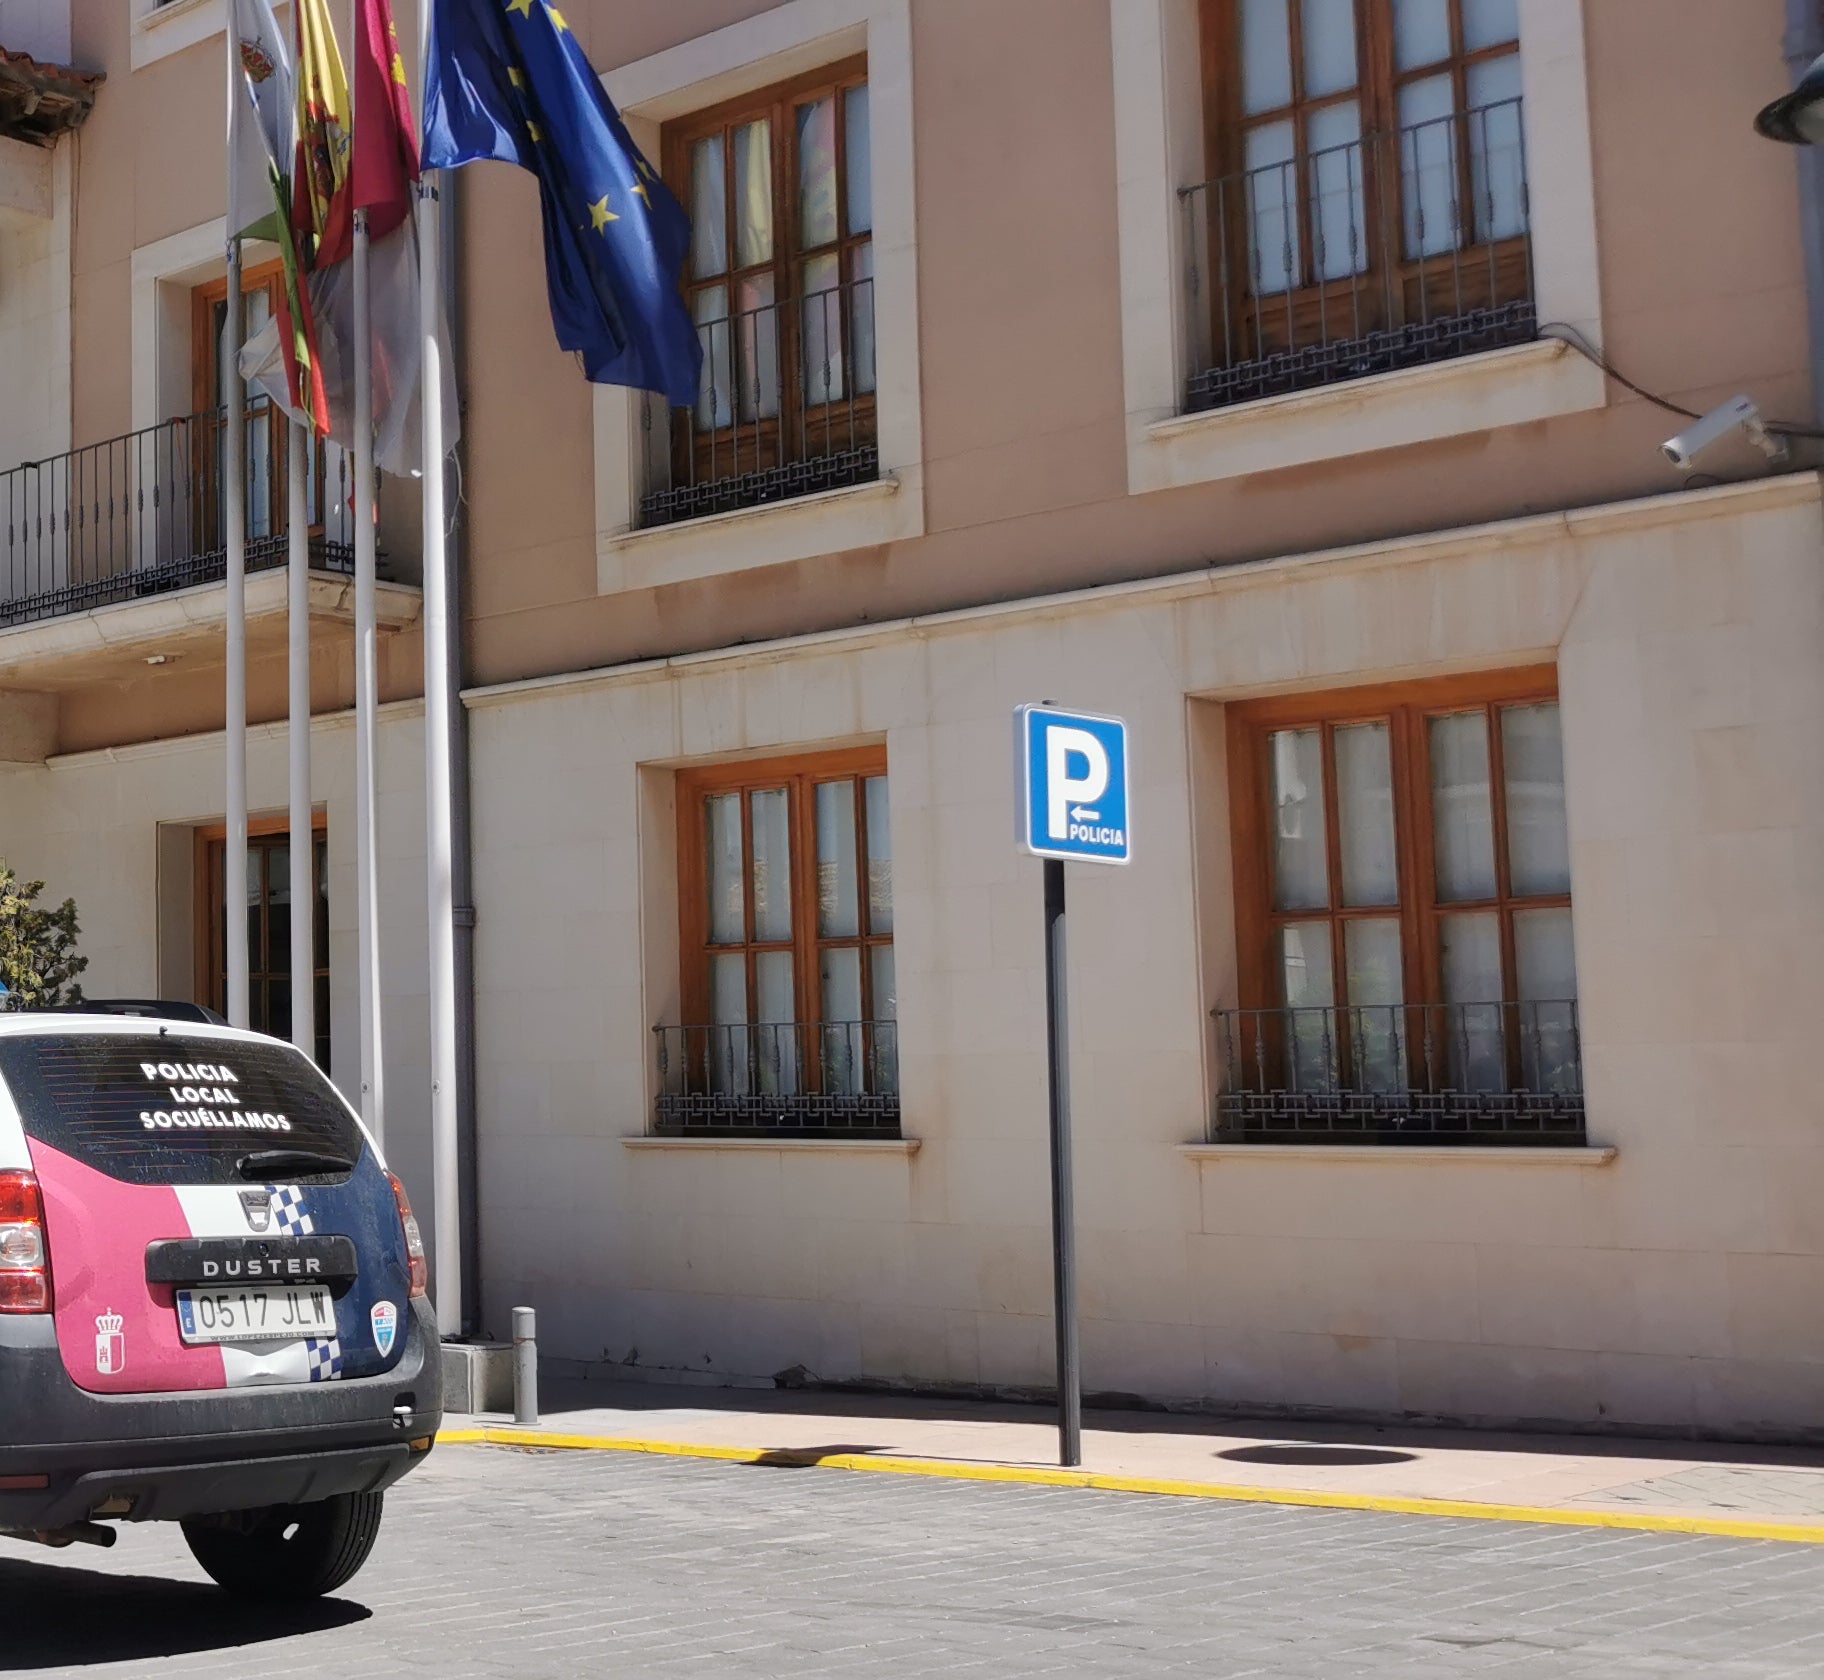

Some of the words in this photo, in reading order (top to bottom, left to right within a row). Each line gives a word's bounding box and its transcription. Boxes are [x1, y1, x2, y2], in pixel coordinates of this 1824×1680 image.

[1047, 725, 1108, 839] P
[1070, 824, 1124, 845] POLICIA
[140, 1063, 238, 1082] POLICIA
[169, 1086, 241, 1104] LOCAL
[140, 1108, 291, 1131] SOCUÉLLAMOS
[203, 1257, 322, 1277] DUSTER
[199, 1292, 268, 1329] 0517
[282, 1290, 326, 1326] JLW
[186, 1318, 192, 1328] E
